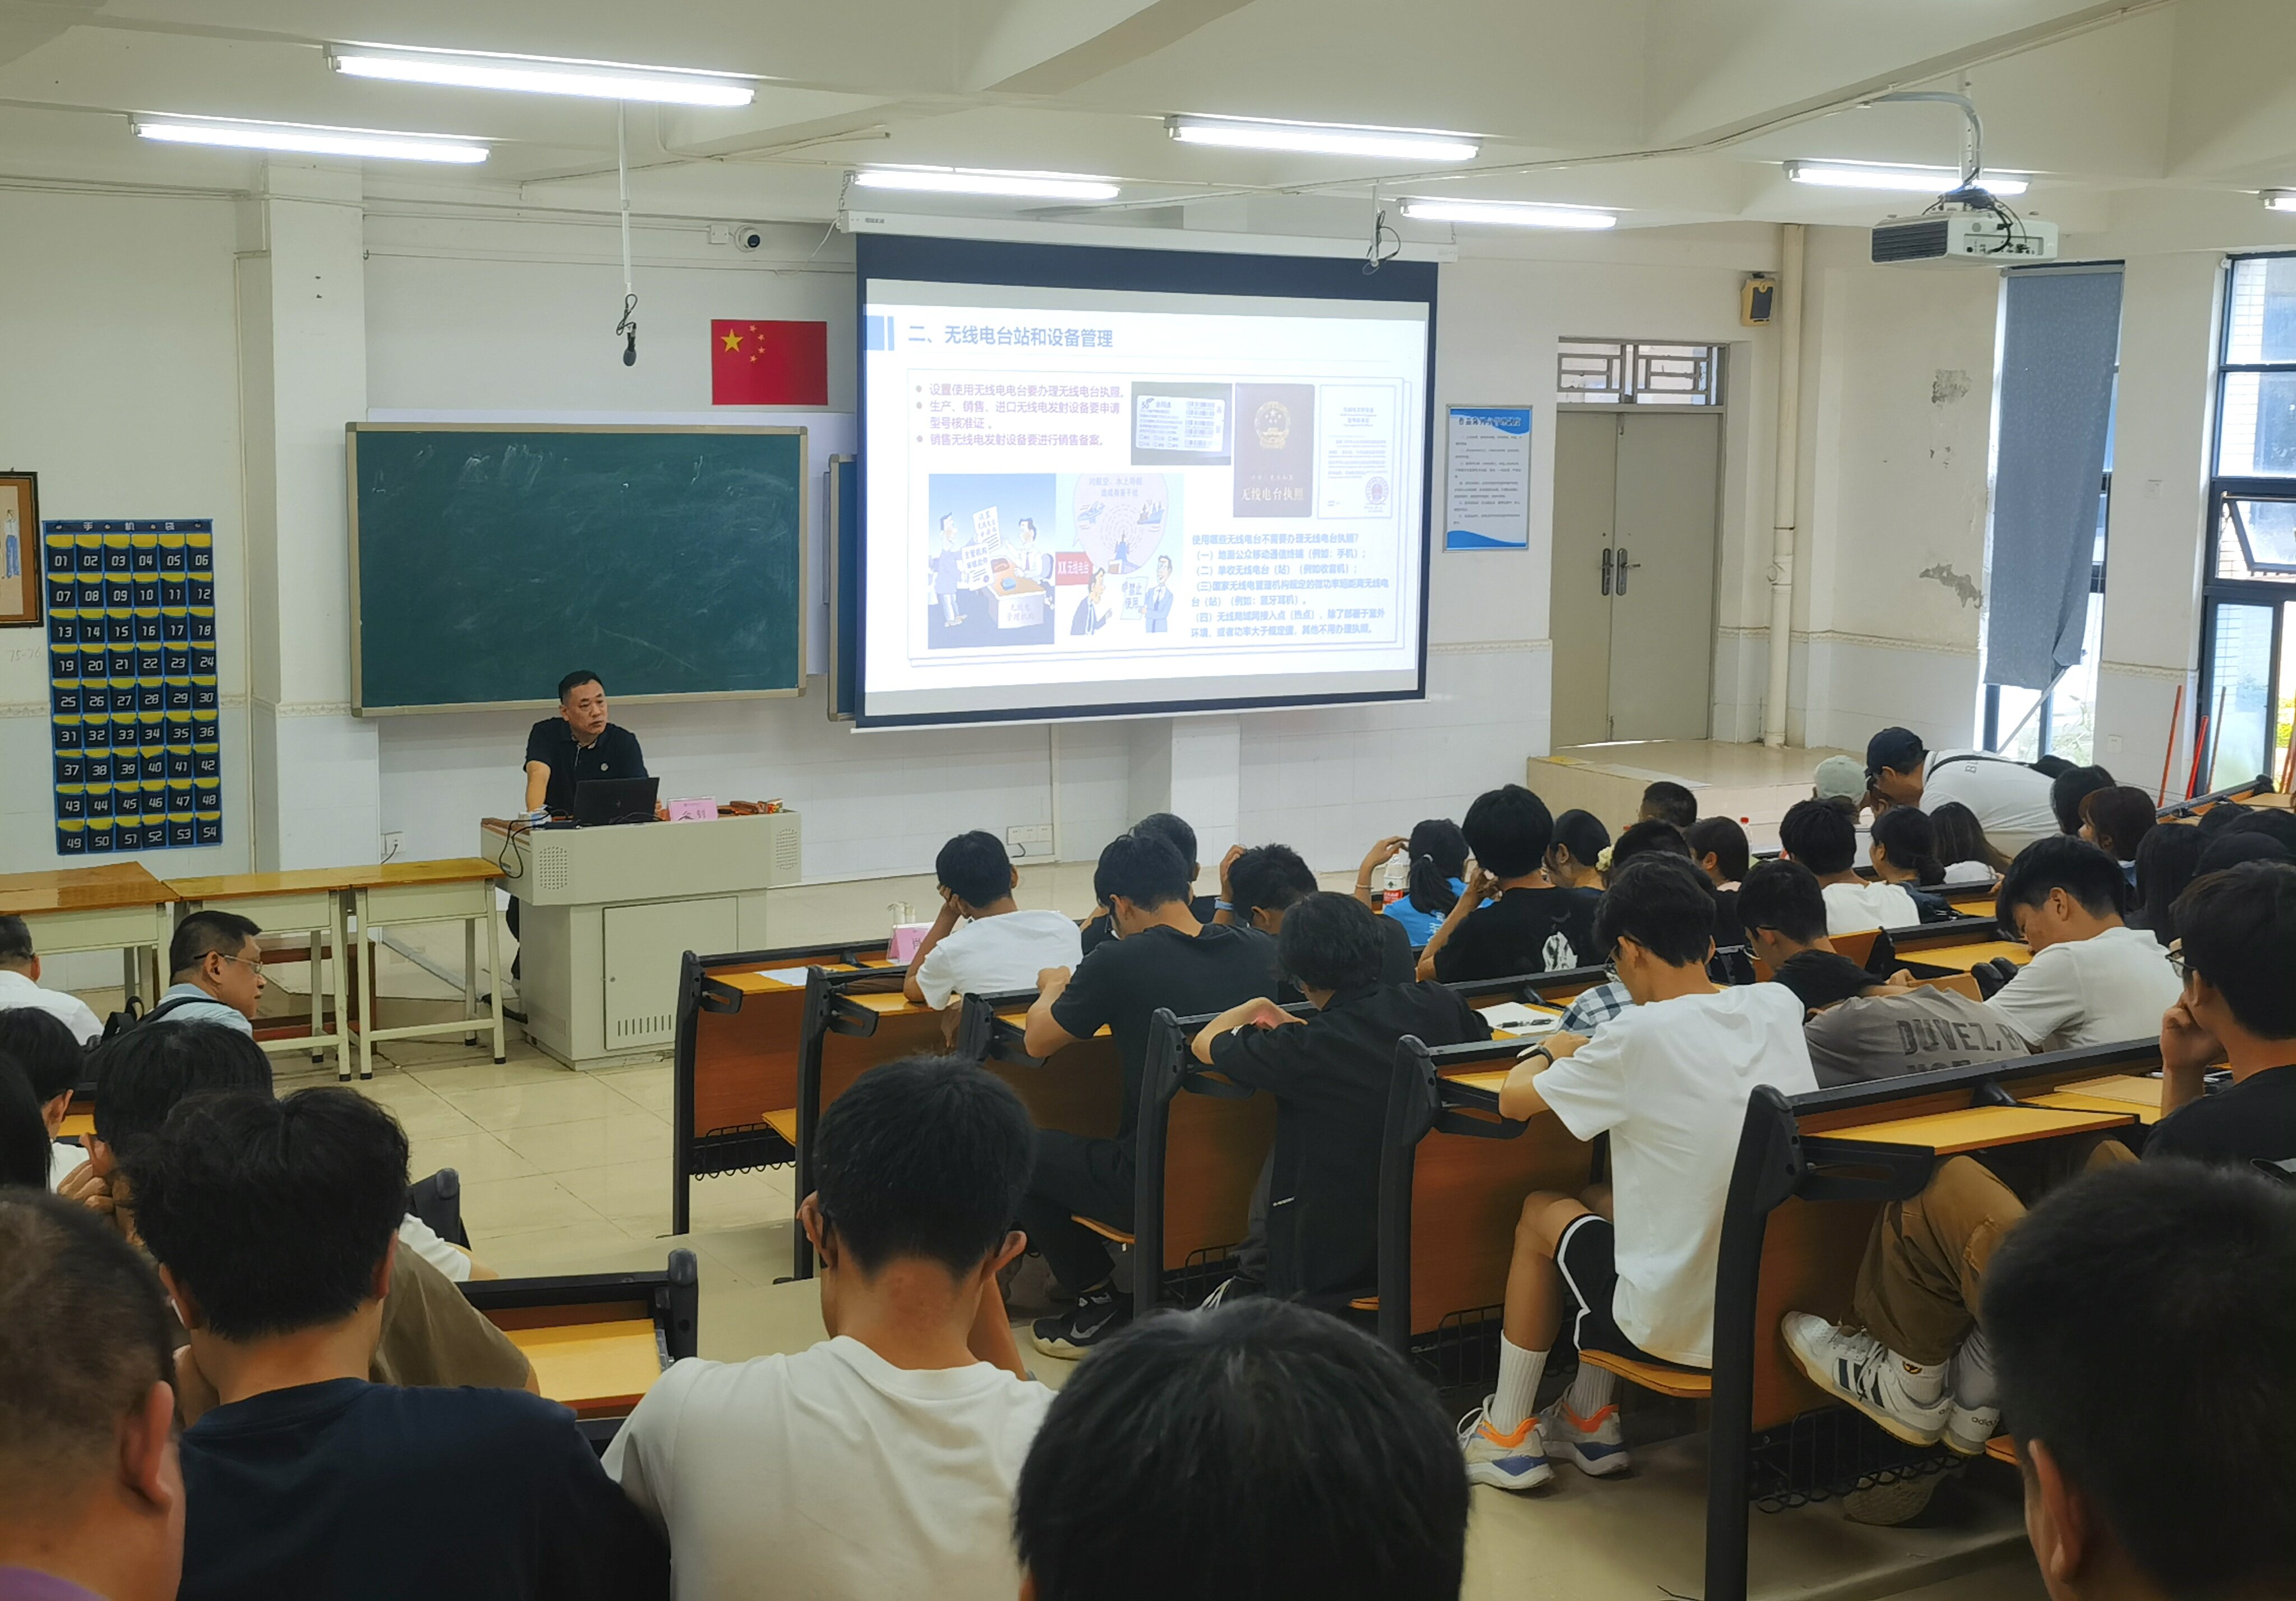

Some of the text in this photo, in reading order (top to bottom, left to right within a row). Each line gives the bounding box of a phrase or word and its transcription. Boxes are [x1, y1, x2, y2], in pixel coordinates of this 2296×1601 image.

[909, 325, 1114, 348] 二、无线电台站和设备管理
[930, 401, 1120, 415] 生产、销售、进口无线电发射设备要申请
[1242, 486, 1304, 502] 无线电台执照
[55, 555, 208, 567] 01 02 03 04 05 06
[56, 588, 211, 601] 07 08 09 10 11 12
[58, 625, 211, 637] 13 14 15 16 17 18
[60, 656, 214, 671] 19 20 21 22 23 24
[61, 693, 213, 707] 25 26 27 28 29 30
[62, 726, 214, 742] 31 32 33 34 35 36
[64, 760, 215, 775] 37 38 39 40 41 42
[65, 794, 216, 811] 43 44 45 46 47 48
[67, 827, 216, 848] 49 50 51 52 53 54
